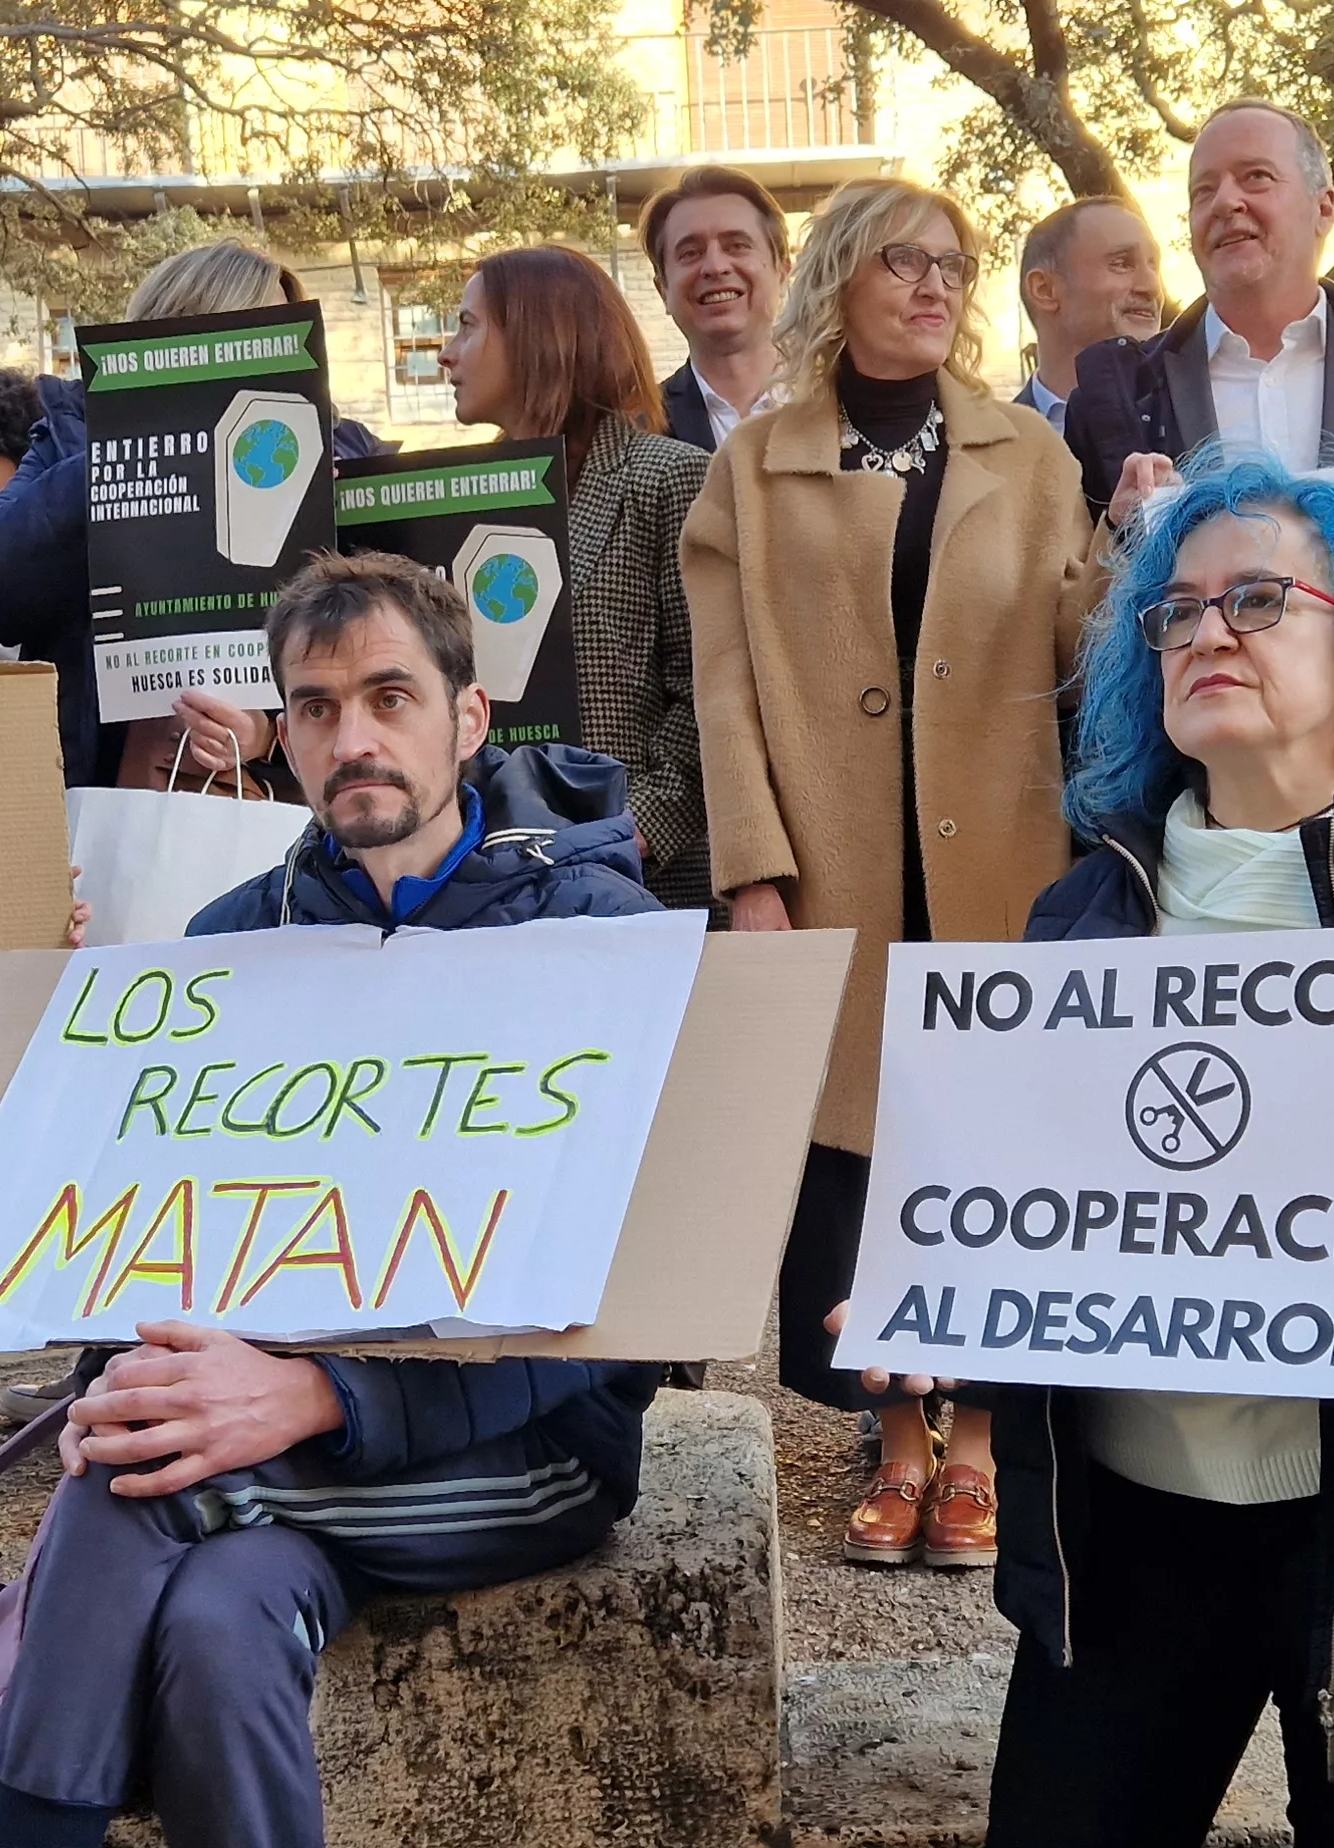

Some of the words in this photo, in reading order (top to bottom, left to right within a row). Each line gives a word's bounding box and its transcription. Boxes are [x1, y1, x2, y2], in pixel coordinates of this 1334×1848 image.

[101, 352, 139, 377] ¡NOS
[144, 344, 210, 372] QUIEREN
[214, 334, 300, 364] ENTERRAR!
[91, 431, 209, 464] ENTIERRO
[91, 463, 126, 484] POR
[137, 460, 158, 479] LA
[90, 474, 188, 502] COOPERACIÓN
[340, 487, 376, 512] ¡NOS
[380, 479, 446, 507] QUIEREN
[451, 469, 537, 499] ENTERRAR!
[90, 495, 201, 522] INTERNACIONAL
[135, 593, 232, 618] AYUNTAMIENTO
[238, 593, 255, 608] DE
[105, 654, 121, 671] NO
[126, 651, 140, 668] AL
[145, 646, 199, 666] RECORTE
[205, 644, 221, 659] EN
[131, 670, 183, 694] HUESCA
[189, 668, 206, 687] ES
[213, 665, 272, 685] SOLIDA
[488, 728, 504, 744] DE
[509, 723, 561, 742] HUESCA
[59, 965, 234, 1047] LOS
[922, 970, 1033, 1033] NO
[1043, 968, 1134, 1031] AL
[114, 1048, 612, 1145] RECORTES
[876, 1284, 966, 1347] AL
